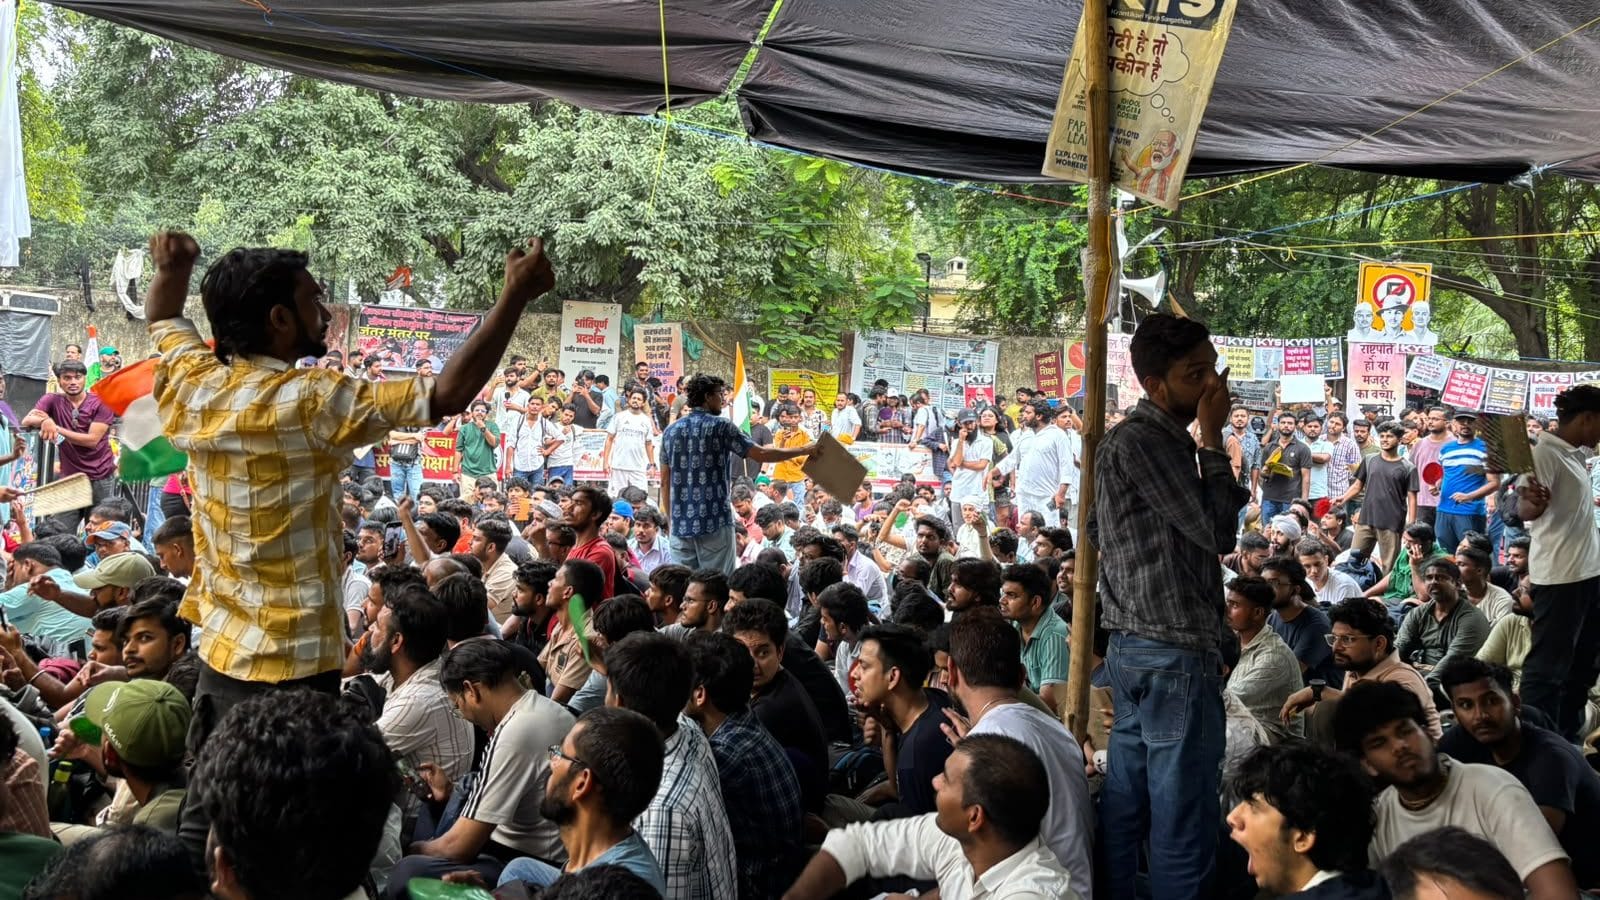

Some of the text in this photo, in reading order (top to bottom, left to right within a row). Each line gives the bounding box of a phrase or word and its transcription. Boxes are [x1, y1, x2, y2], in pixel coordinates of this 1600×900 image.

[1136, 29, 1149, 55] है
[1152, 33, 1168, 56] तो
[1151, 57, 1162, 82] है
[1067, 118, 1088, 134] PAP
[1067, 131, 1088, 146] LEA
[1055, 149, 1088, 161] EXPLOITE
[574, 316, 609, 333] शांतिपूर्ण
[359, 325, 385, 337] जंतर
[388, 327, 413, 339] मंतर
[575, 331, 606, 345] प्रदर्शन
[1210, 335, 1224, 343] YS
[1227, 338, 1253, 346] KYS
[1257, 338, 1282, 346] KYS
[1285, 338, 1310, 347] KYS
[1314, 337, 1337, 346] KYS
[1364, 357, 1390, 371] हो या
[1455, 361, 1487, 374] KYS
[966, 375, 993, 384] KYS
[1494, 370, 1526, 380] KYS
[1535, 374, 1570, 383] KYS
[1576, 372, 1600, 381] KY
[1361, 375, 1391, 389] मजदूर
[1354, 389, 1369, 399] का
[1535, 393, 1555, 408] NT
